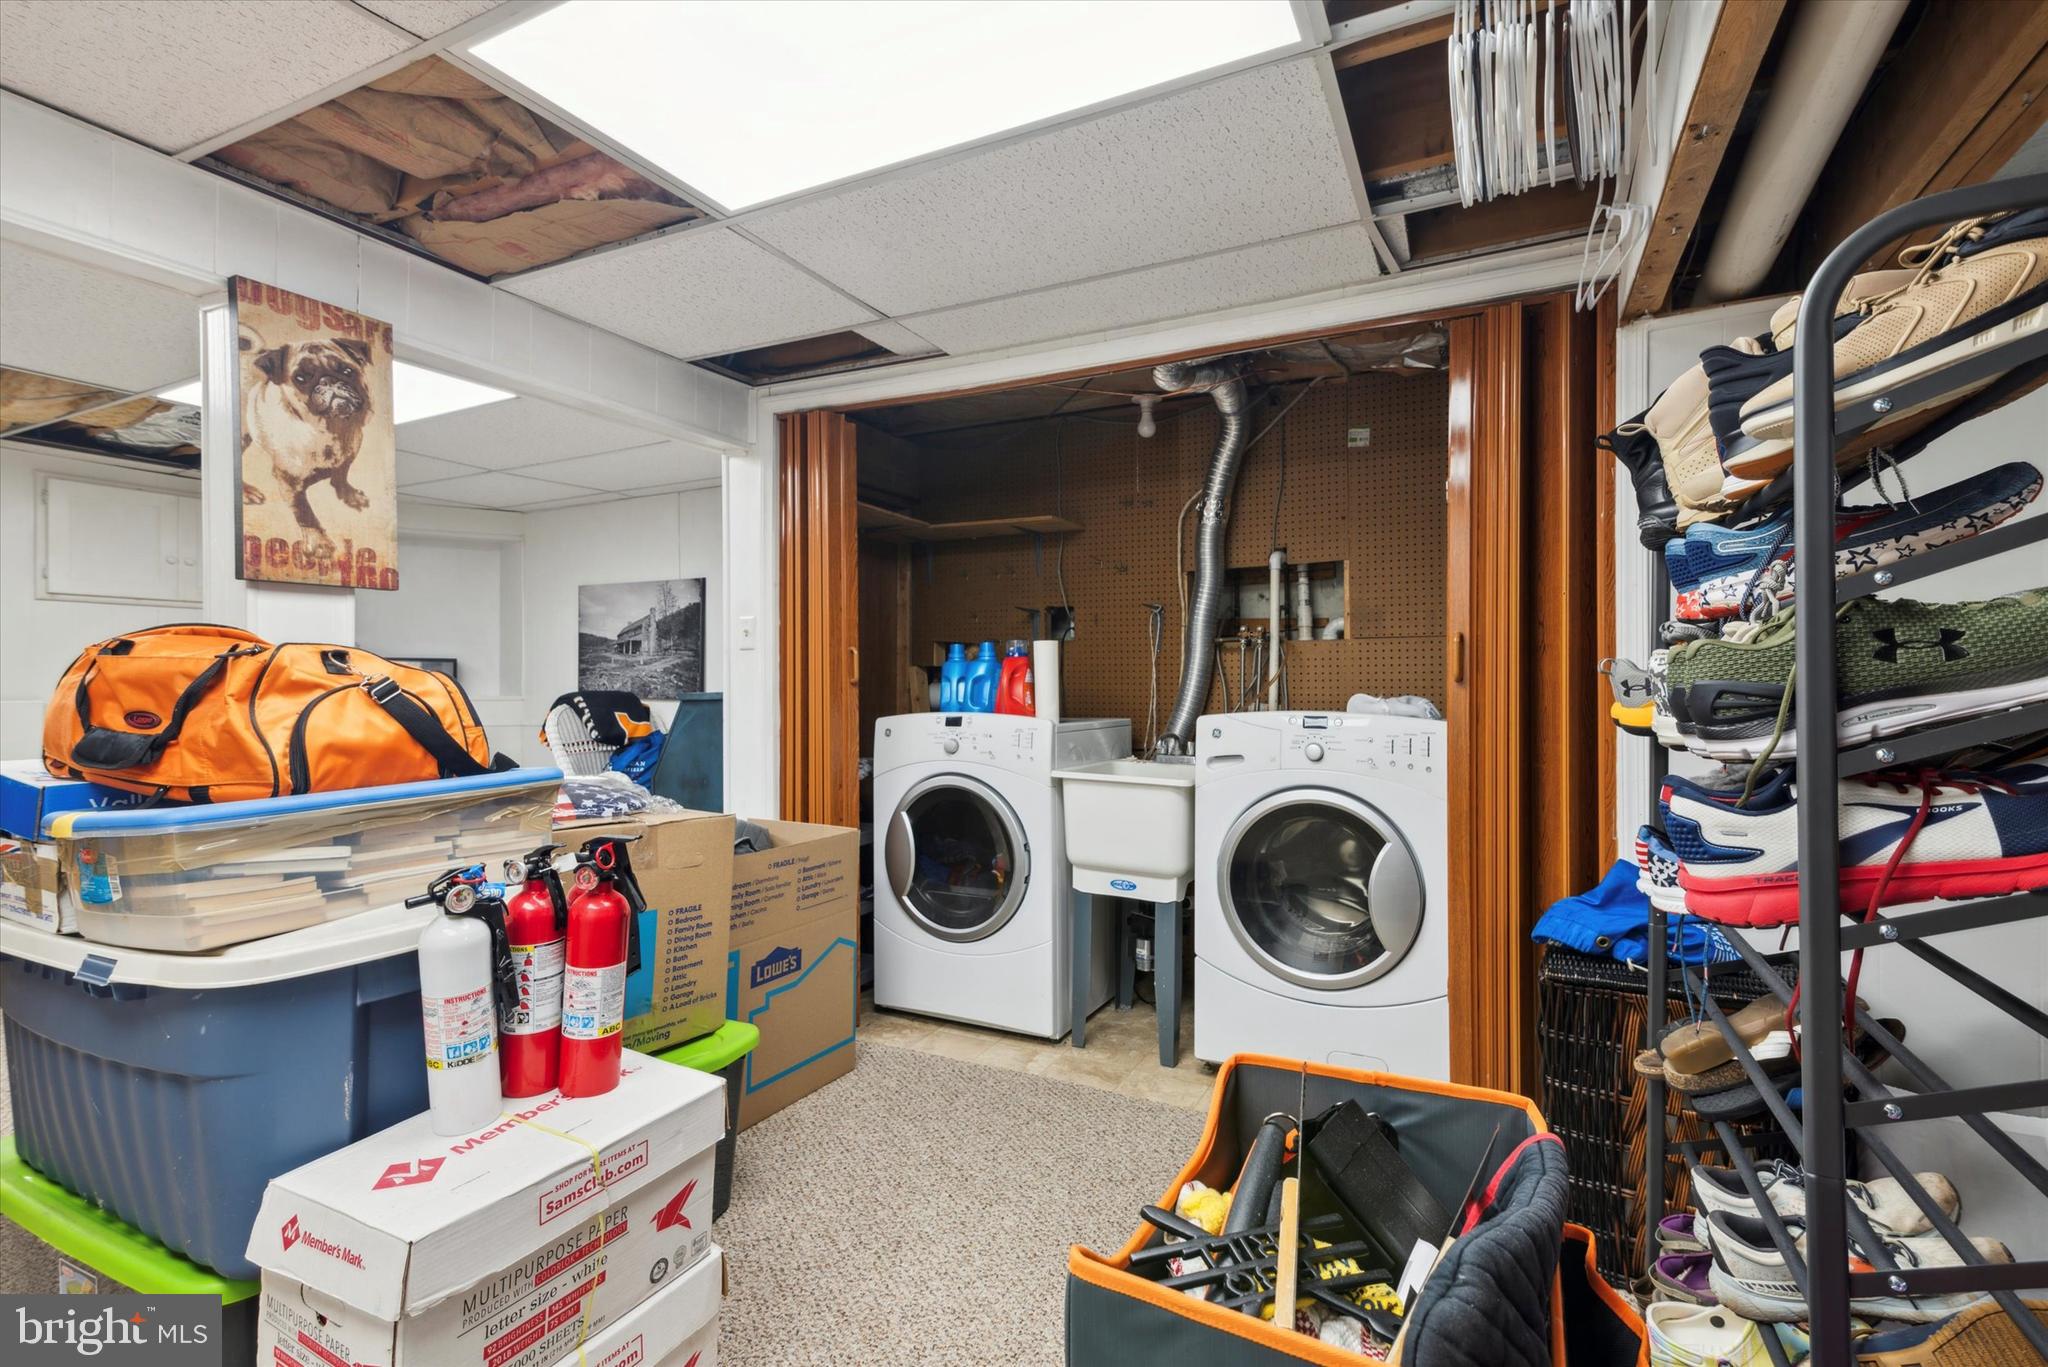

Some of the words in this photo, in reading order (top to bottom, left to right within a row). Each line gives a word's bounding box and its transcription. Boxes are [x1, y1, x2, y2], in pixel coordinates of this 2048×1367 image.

[1916, 804, 1963, 814] BOOKS
[732, 881, 752, 891] droom
[675, 904, 703, 915] FRAGILE
[675, 914, 704, 924] Bedroom
[674, 924, 696, 935] Family
[696, 921, 713, 930] Room
[674, 934, 695, 944] Dining
[695, 931, 713, 940] Room
[673, 943, 698, 953] Kitchen
[672, 954, 689, 963] Bath
[672, 959, 704, 973] Basement
[757, 955, 797, 982] LOWE'S
[672, 973, 688, 982] Attic
[670, 980, 697, 992] Laundry
[443, 986, 488, 1005] INSTRUCTIONS
[670, 990, 694, 1001] Garage
[675, 999, 692, 1009] Load
[700, 992, 718, 1002] Bricks
[601, 1022, 621, 1035] ABC
[426, 1059, 440, 1069] BC
[555, 1177, 573, 1193] SHOP
[574, 1170, 588, 1182] FOR
[588, 1160, 606, 1174] MRE
[607, 1149, 627, 1165] ITEMS
[627, 1144, 637, 1154] AT
[301, 1230, 341, 1259] Member's
[341, 1247, 363, 1270] Mark
[463, 1232, 583, 1316] MULTIPURPOSE
[588, 1205, 629, 1241] PAPER
[462, 1295, 511, 1329] PRODUCED
[513, 1280, 534, 1297] WITH
[582, 1224, 627, 1255] TECHOLOGY
[484, 1306, 526, 1340] letter
[530, 1286, 558, 1312] size
[572, 1254, 608, 1284] white
[487, 1342, 497, 1355] 92
[498, 1313, 545, 1349] BRIGHTNESS
[565, 1274, 603, 1305] WHITENS
[266, 1293, 322, 1345] MULTIPURPOSE
[326, 1334, 350, 1363] PAPER
[539, 1315, 585, 1355] SHEETS
[277, 1332, 294, 1354] letter
[503, 1349, 512, 1361] LB
[513, 1329, 542, 1351] WEIGHT
[549, 1317, 559, 1328] 75
[600, 1349, 621, 1367] ITEMS
[621, 1342, 630, 1352] AT
